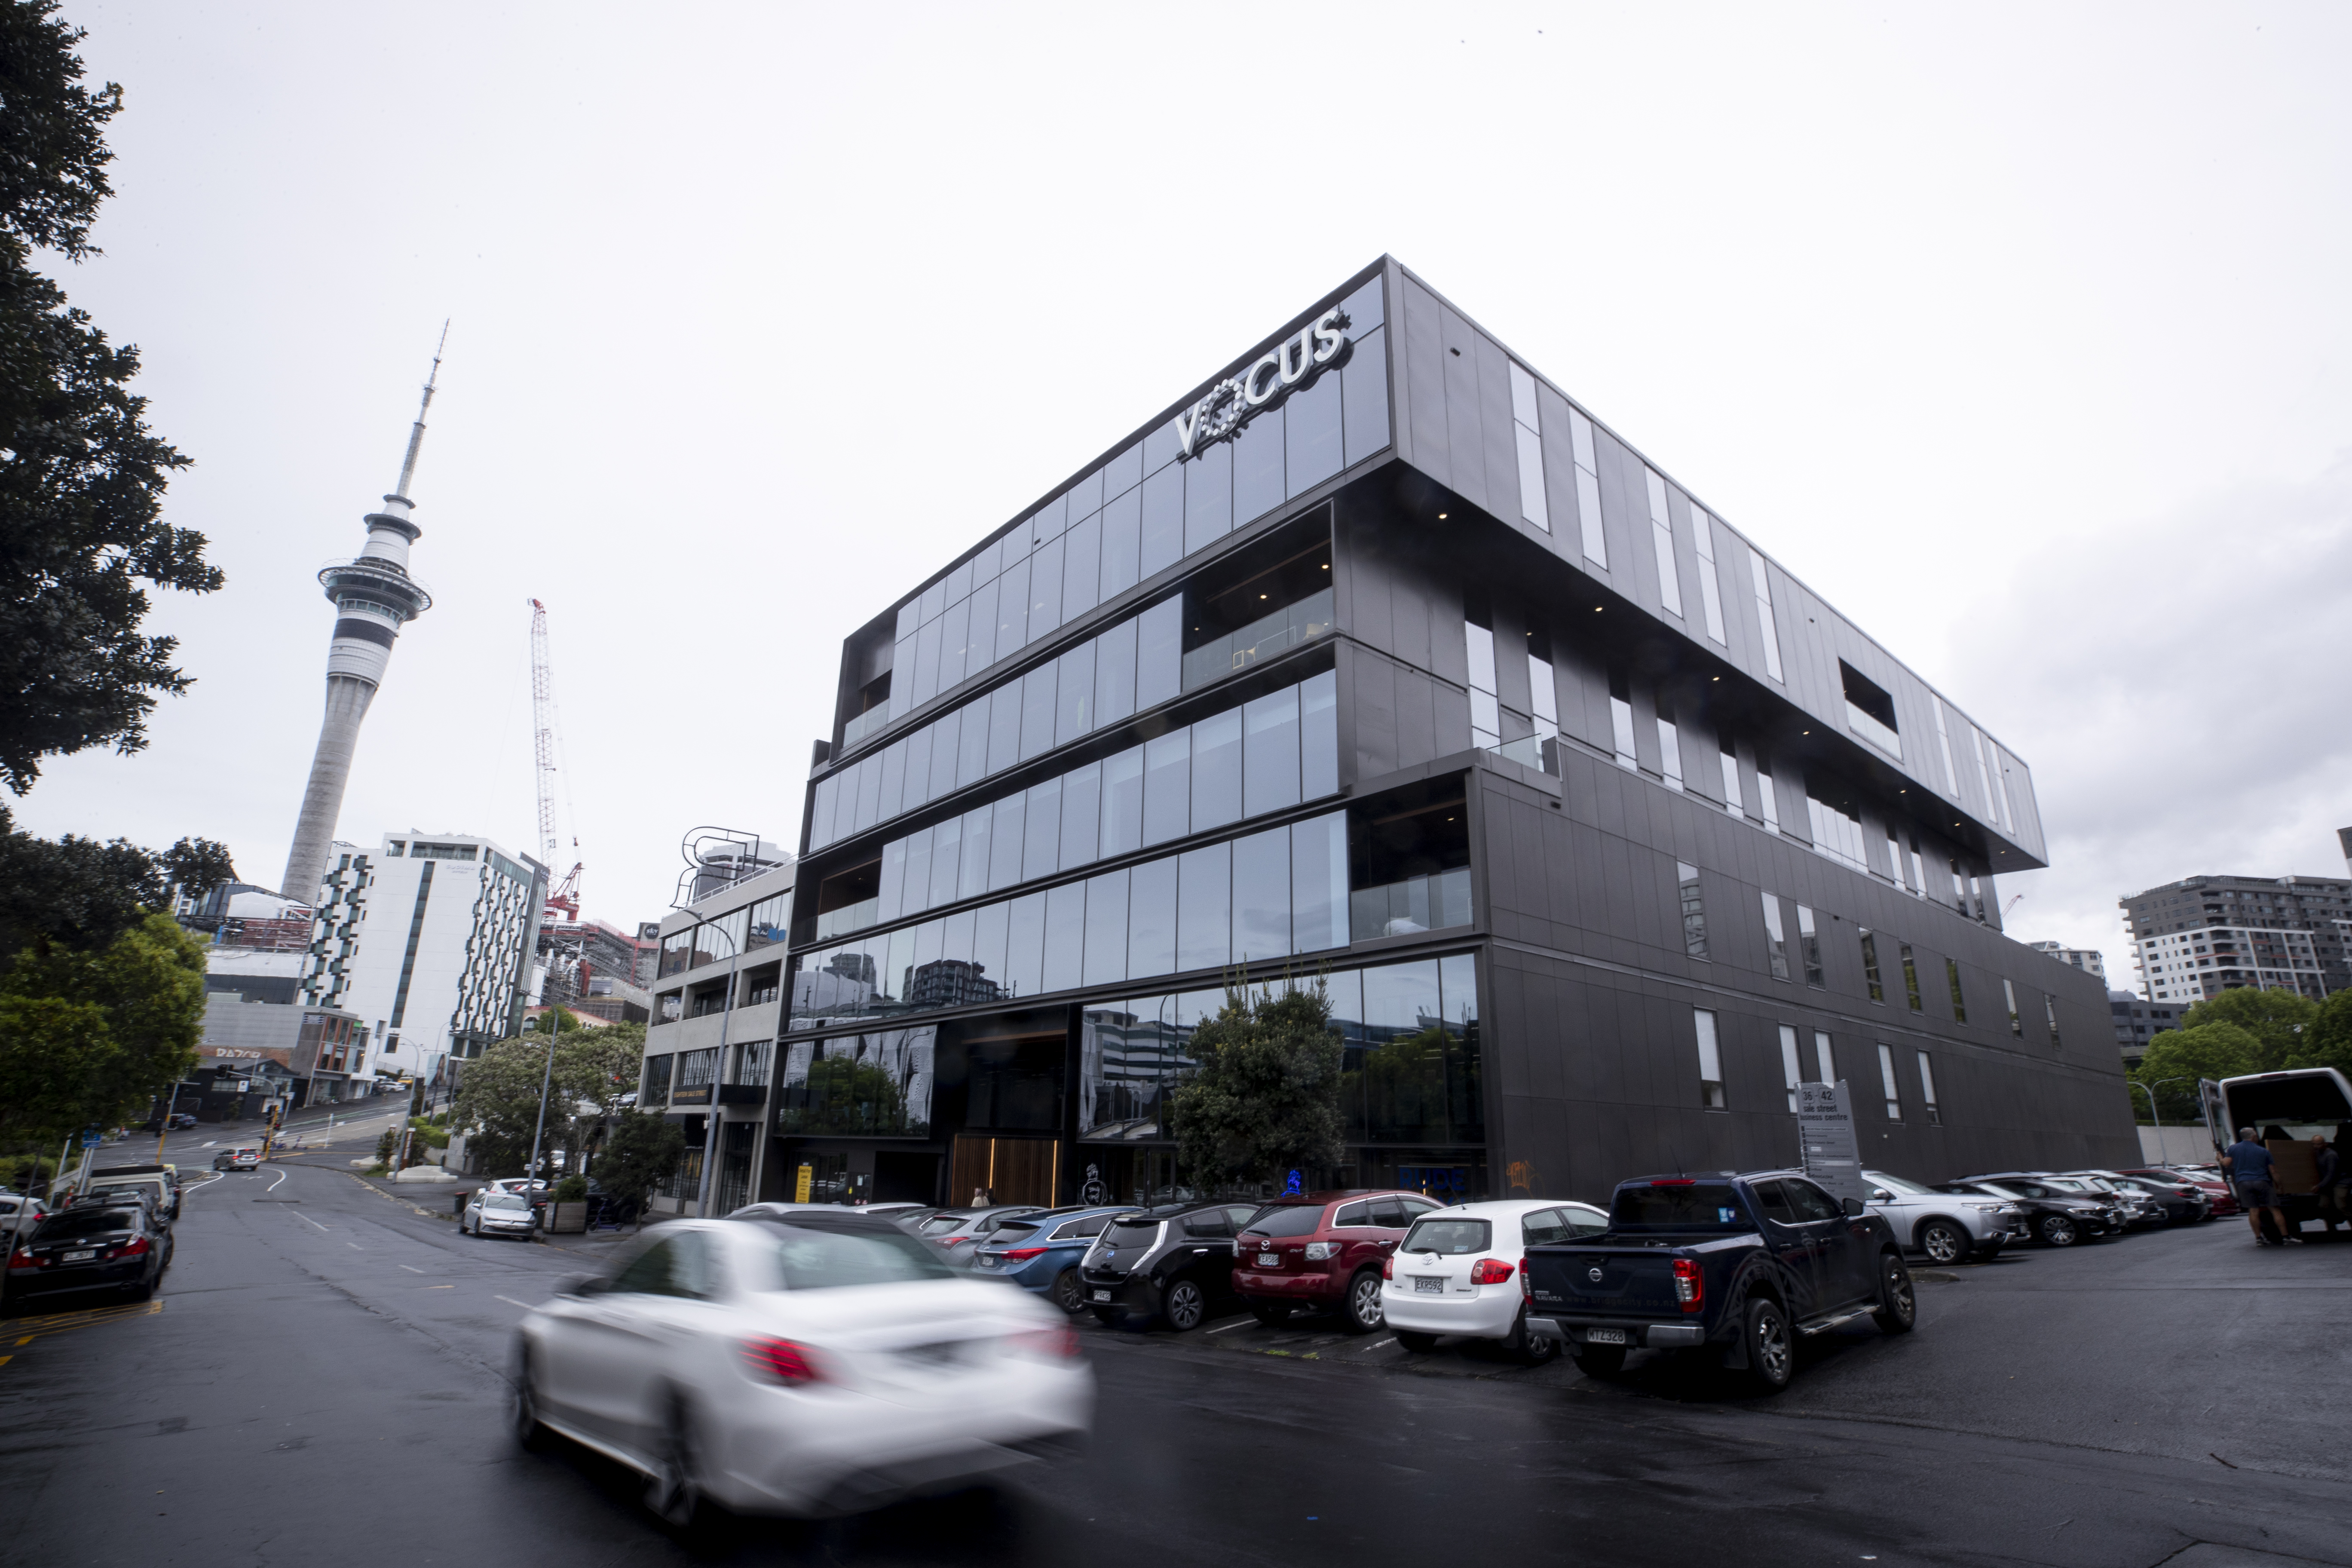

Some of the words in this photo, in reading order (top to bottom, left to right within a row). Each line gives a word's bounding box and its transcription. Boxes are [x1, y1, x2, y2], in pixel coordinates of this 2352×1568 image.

[1174, 309, 1345, 456] VOCUS
[646, 927, 658, 935] sky
[1803, 1091, 1813, 1101] 36
[1821, 1090, 1833, 1101] 42
[1803, 1103, 1815, 1112] sale
[1816, 1104, 1838, 1112] street
[1399, 1167, 1465, 1191] RUDE
[1417, 1280, 1441, 1289] EKR592
[1567, 1296, 1676, 1307] www.bridgecity.co.nz
[1589, 1329, 1624, 1342] MTZ328
